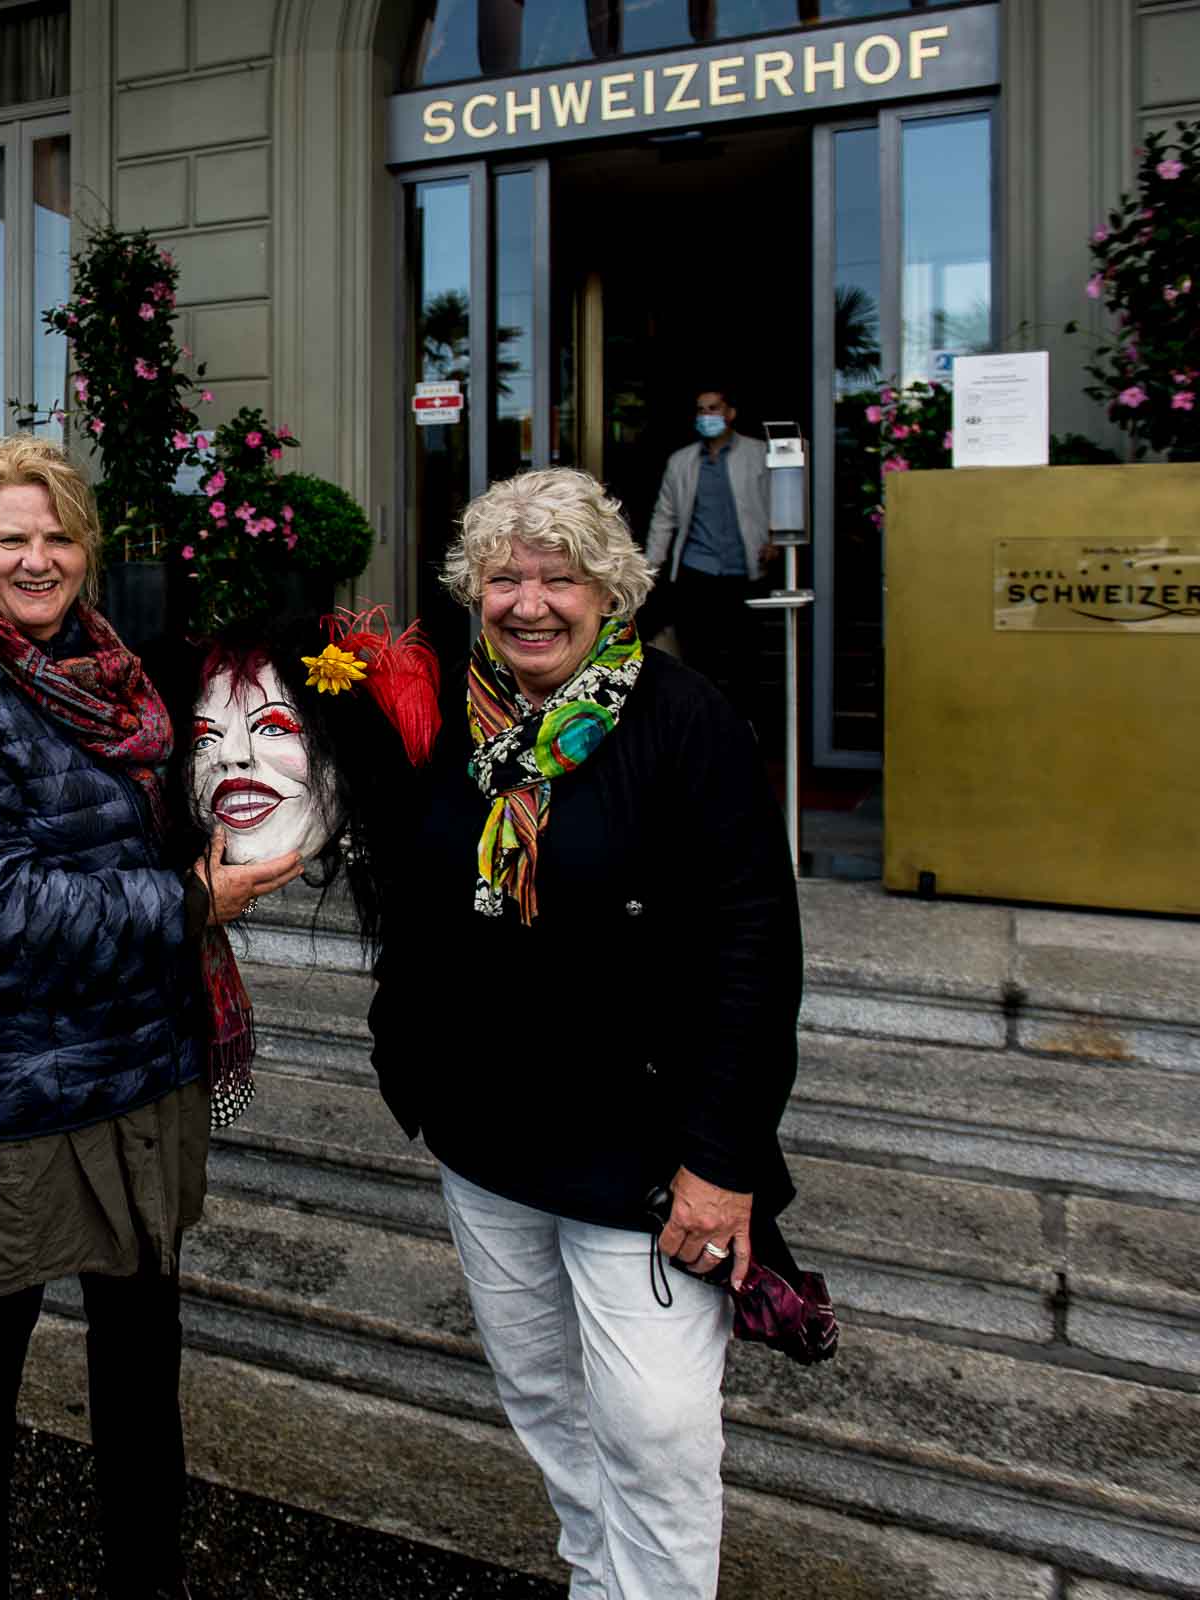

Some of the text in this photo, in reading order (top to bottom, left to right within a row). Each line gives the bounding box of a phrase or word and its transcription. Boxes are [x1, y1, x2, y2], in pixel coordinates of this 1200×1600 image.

[422, 25, 949, 145] SCHWEIZERHOF
[1008, 570, 1067, 579] HOTEL
[1008, 584, 1200, 605] SCHWEIZER
